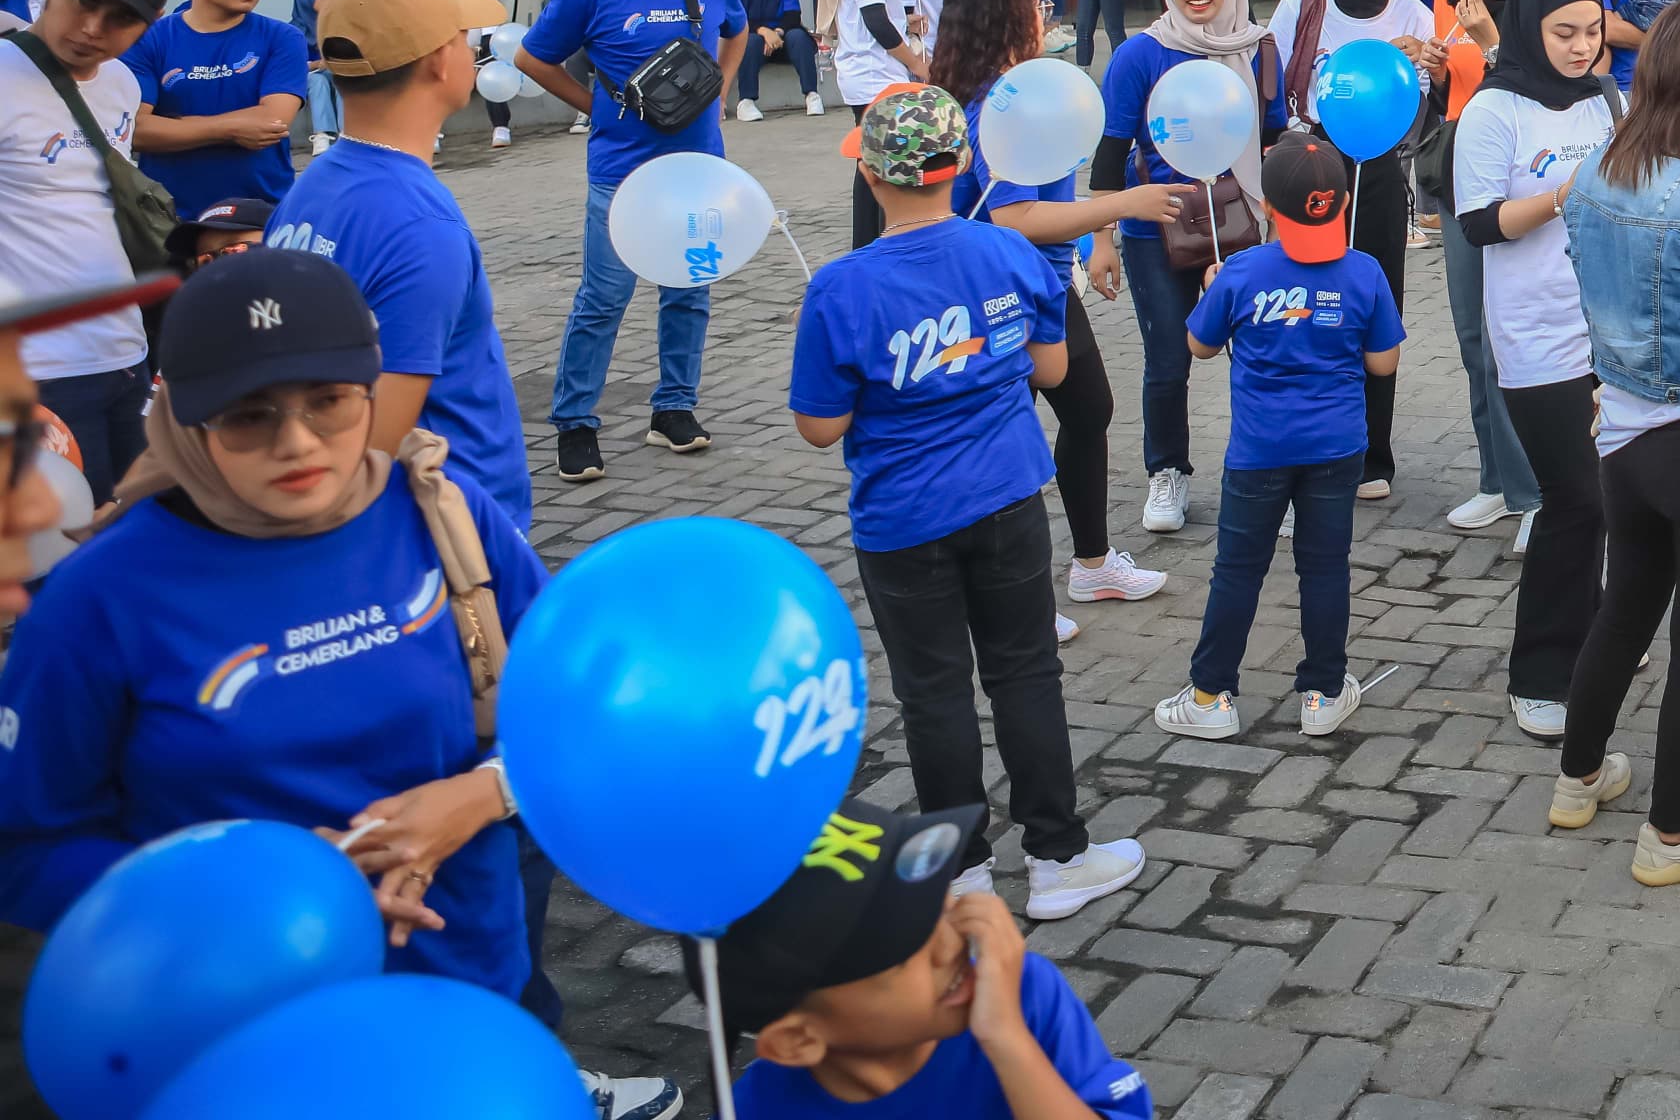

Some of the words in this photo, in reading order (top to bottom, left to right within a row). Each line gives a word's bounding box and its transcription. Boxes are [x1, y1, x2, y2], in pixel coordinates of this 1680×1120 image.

[187, 68, 233, 80] CEMERLANG
[193, 64, 221, 74] BRILIAN
[1558, 152, 1588, 162] CEMER
[1561, 144, 1591, 153] BRILIAN
[992, 291, 1020, 312] BRI
[1252, 286, 1308, 326] 129
[888, 305, 972, 391] 129
[285, 608, 367, 650] BRILIAN
[368, 604, 387, 625] &
[275, 625, 400, 675] CEMERLANG
[753, 658, 860, 778] 129
